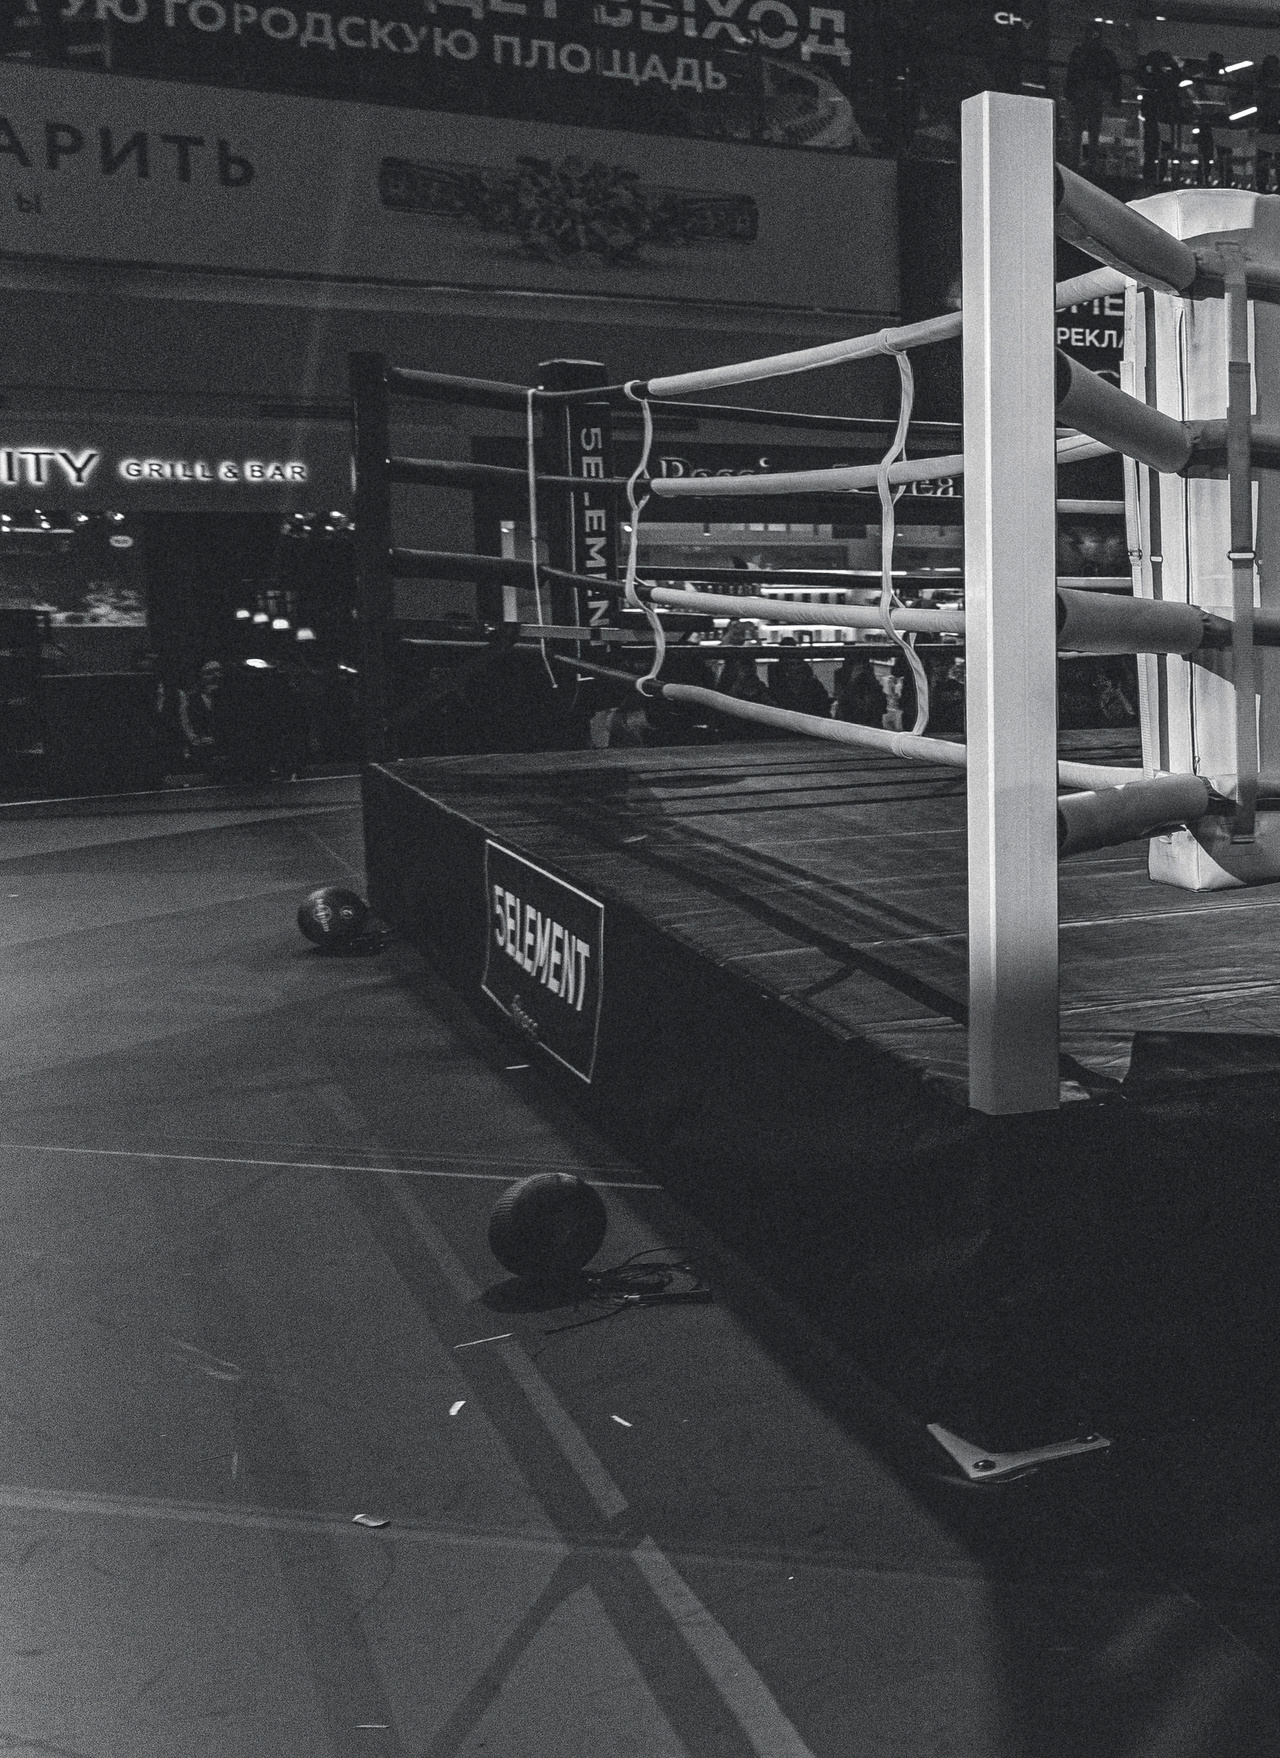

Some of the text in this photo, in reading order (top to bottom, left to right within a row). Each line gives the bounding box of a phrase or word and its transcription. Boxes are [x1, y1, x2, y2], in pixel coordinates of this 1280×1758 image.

[164, 0, 478, 62] ГОРОДСКУЮ
[493, 33, 728, 93] ПЛОЩАДЬ
[494, 884, 591, 1012] 5ELEMENT
